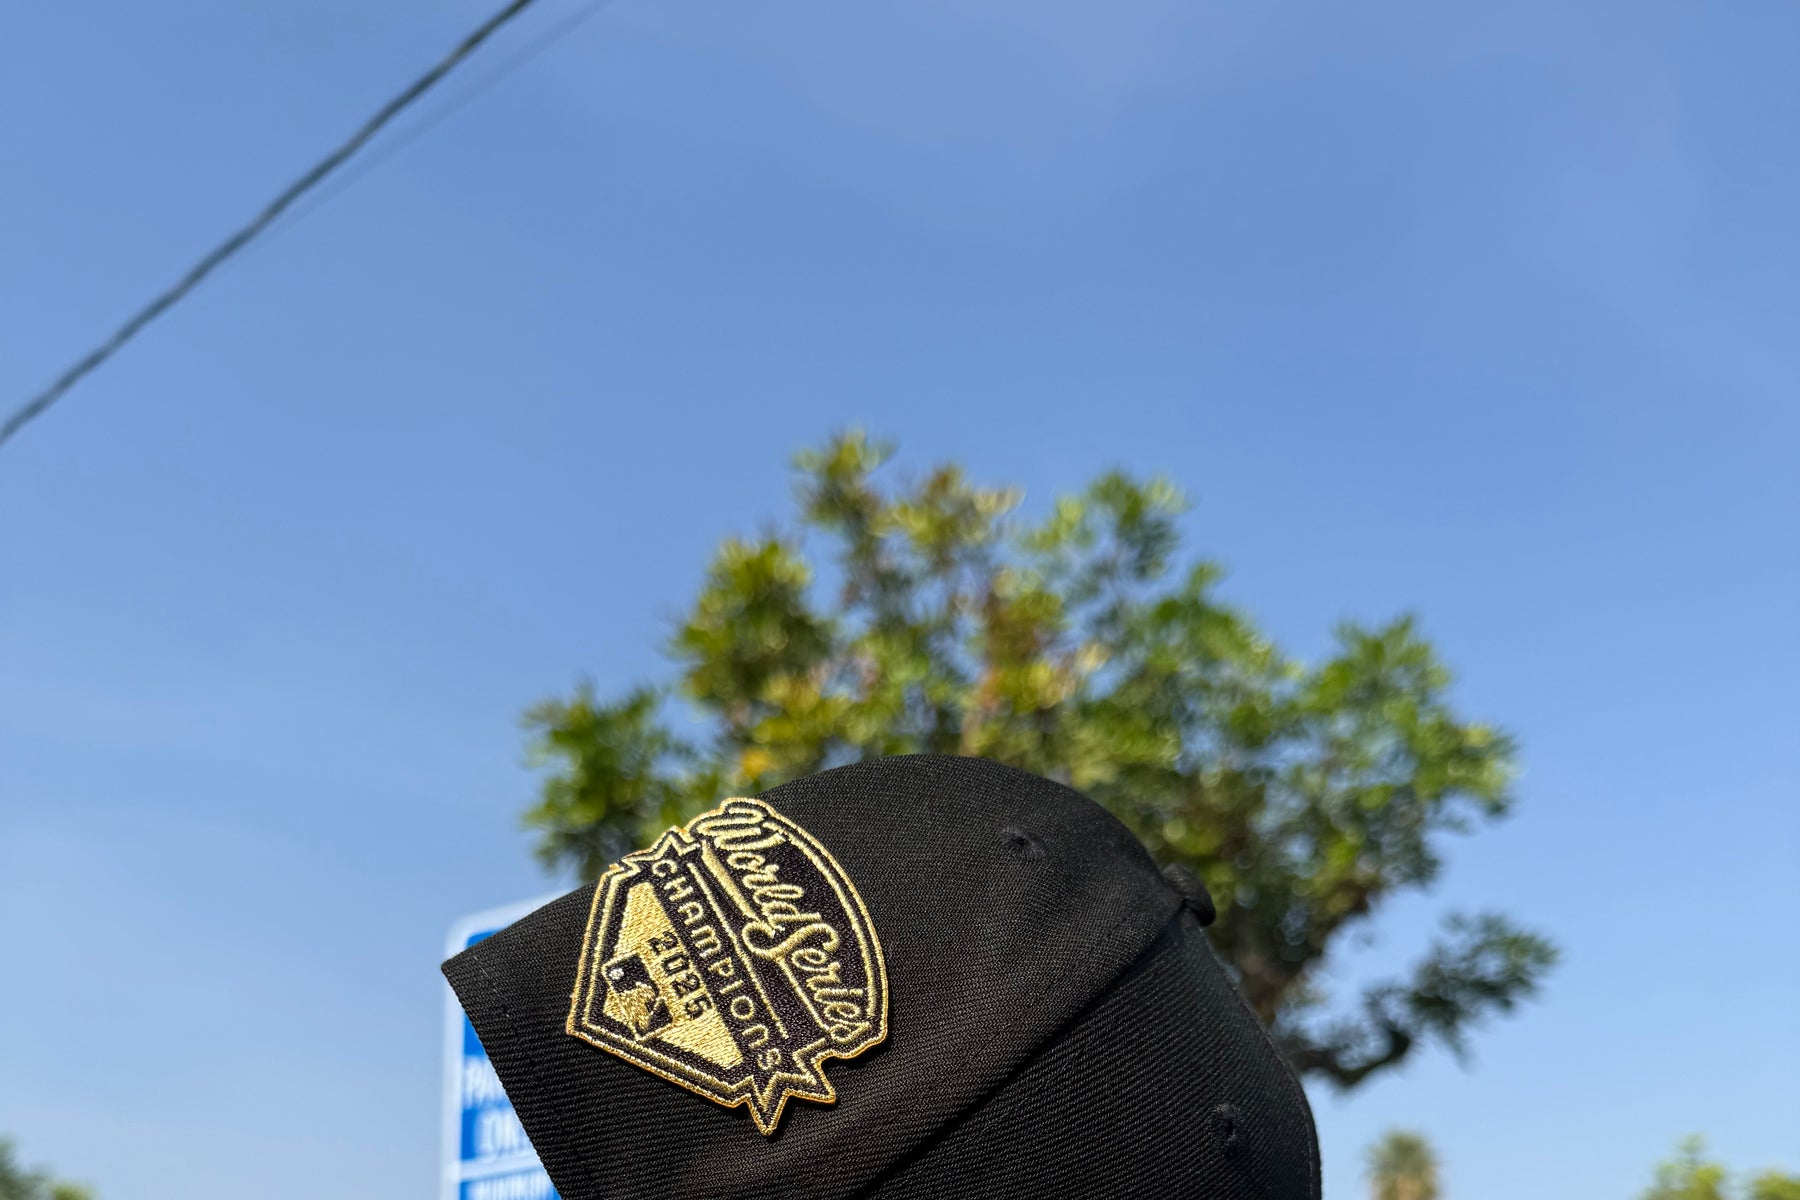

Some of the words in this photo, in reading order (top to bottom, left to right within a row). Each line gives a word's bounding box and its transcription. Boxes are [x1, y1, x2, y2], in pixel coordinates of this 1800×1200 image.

[697, 807, 822, 931] World
[648, 931, 713, 1020] 2025
[651, 858, 781, 1071] CHAMPIONS
[742, 918, 871, 1043] Series
